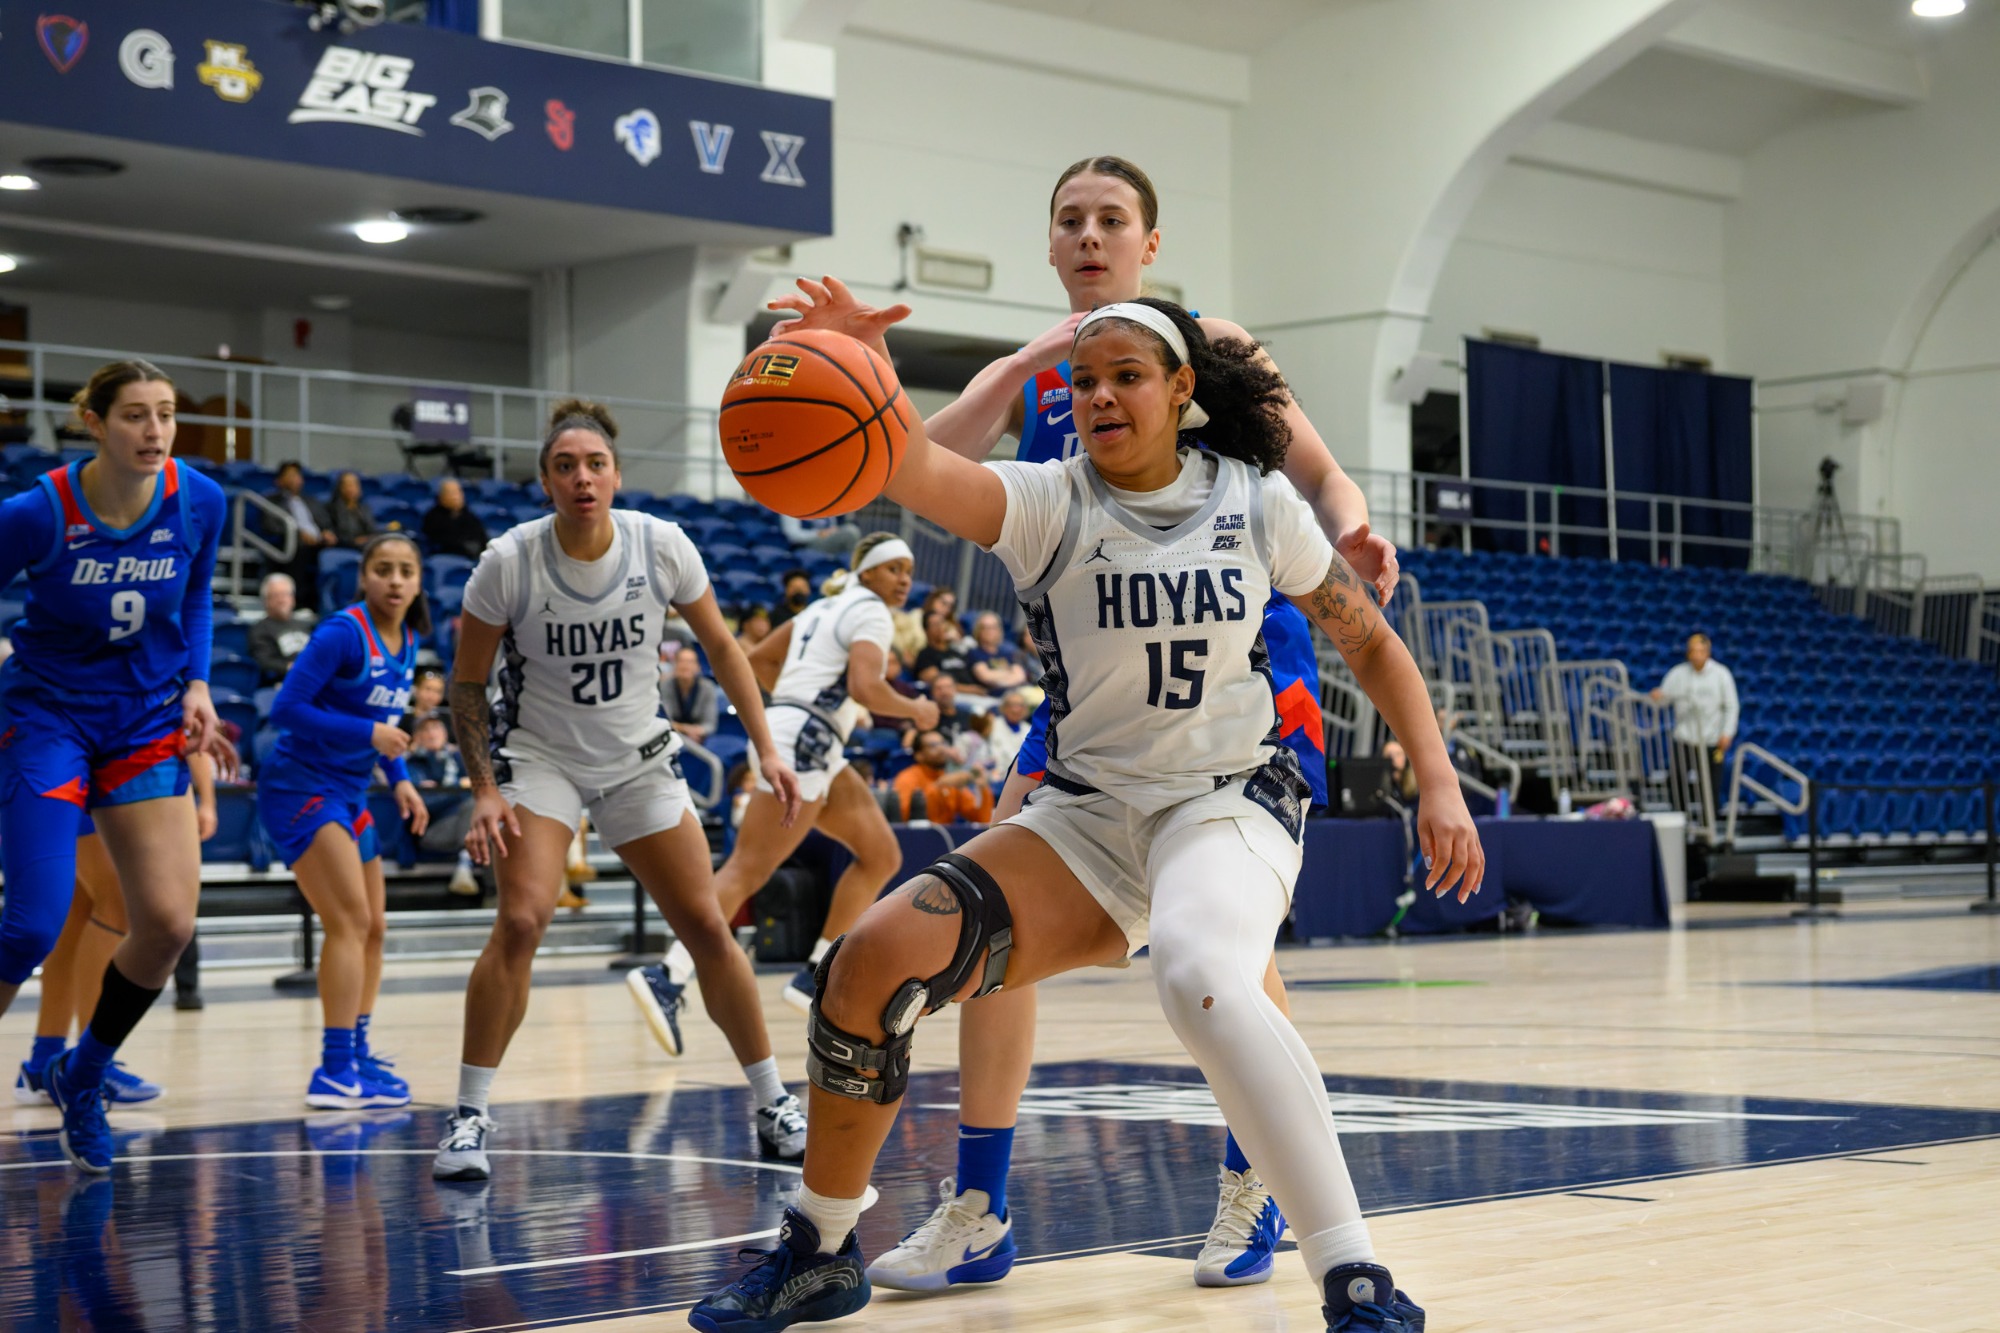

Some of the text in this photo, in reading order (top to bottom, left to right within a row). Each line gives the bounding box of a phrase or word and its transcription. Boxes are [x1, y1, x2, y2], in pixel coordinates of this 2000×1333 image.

[119, 28, 175, 90] G
[314, 45, 415, 91] BIG
[298, 76, 438, 125] EAST
[688, 119, 735, 175] V
[758, 130, 807, 188] X
[1041, 393, 1069, 405] CHANGE
[1043, 387, 1069, 398] BE THE
[1213, 522, 1246, 530] CHANGE
[1229, 514, 1244, 522] THE
[109, 589, 146, 642] 9
[1095, 568, 1246, 629] HOYAS
[545, 613, 646, 656] HOYAS
[571, 659, 624, 706] 20
[1145, 638, 1208, 710] 15
